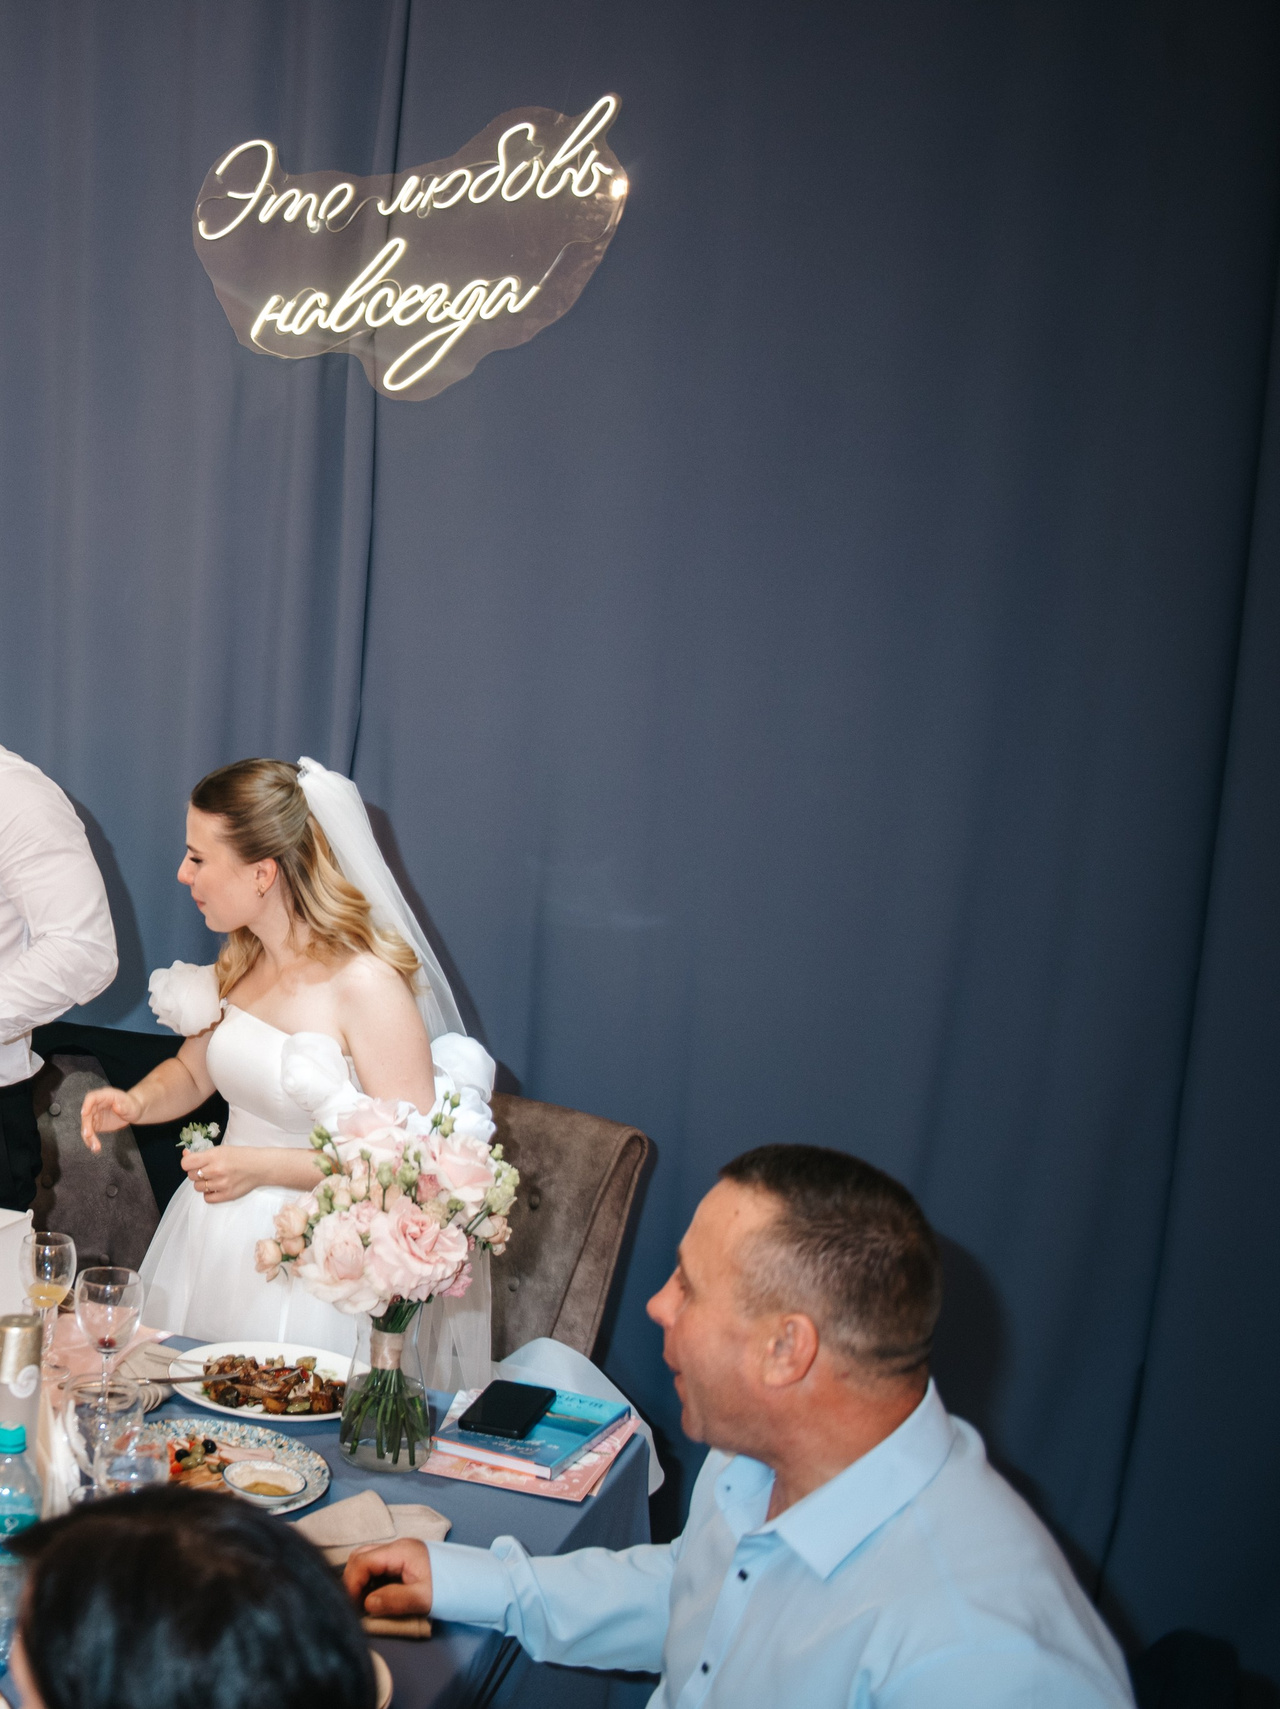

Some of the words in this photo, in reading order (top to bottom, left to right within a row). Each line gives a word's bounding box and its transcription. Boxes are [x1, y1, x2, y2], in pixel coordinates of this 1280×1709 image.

[197, 139, 355, 241] Это
[375, 95, 617, 216] любовь
[250, 237, 540, 391] навсегда
